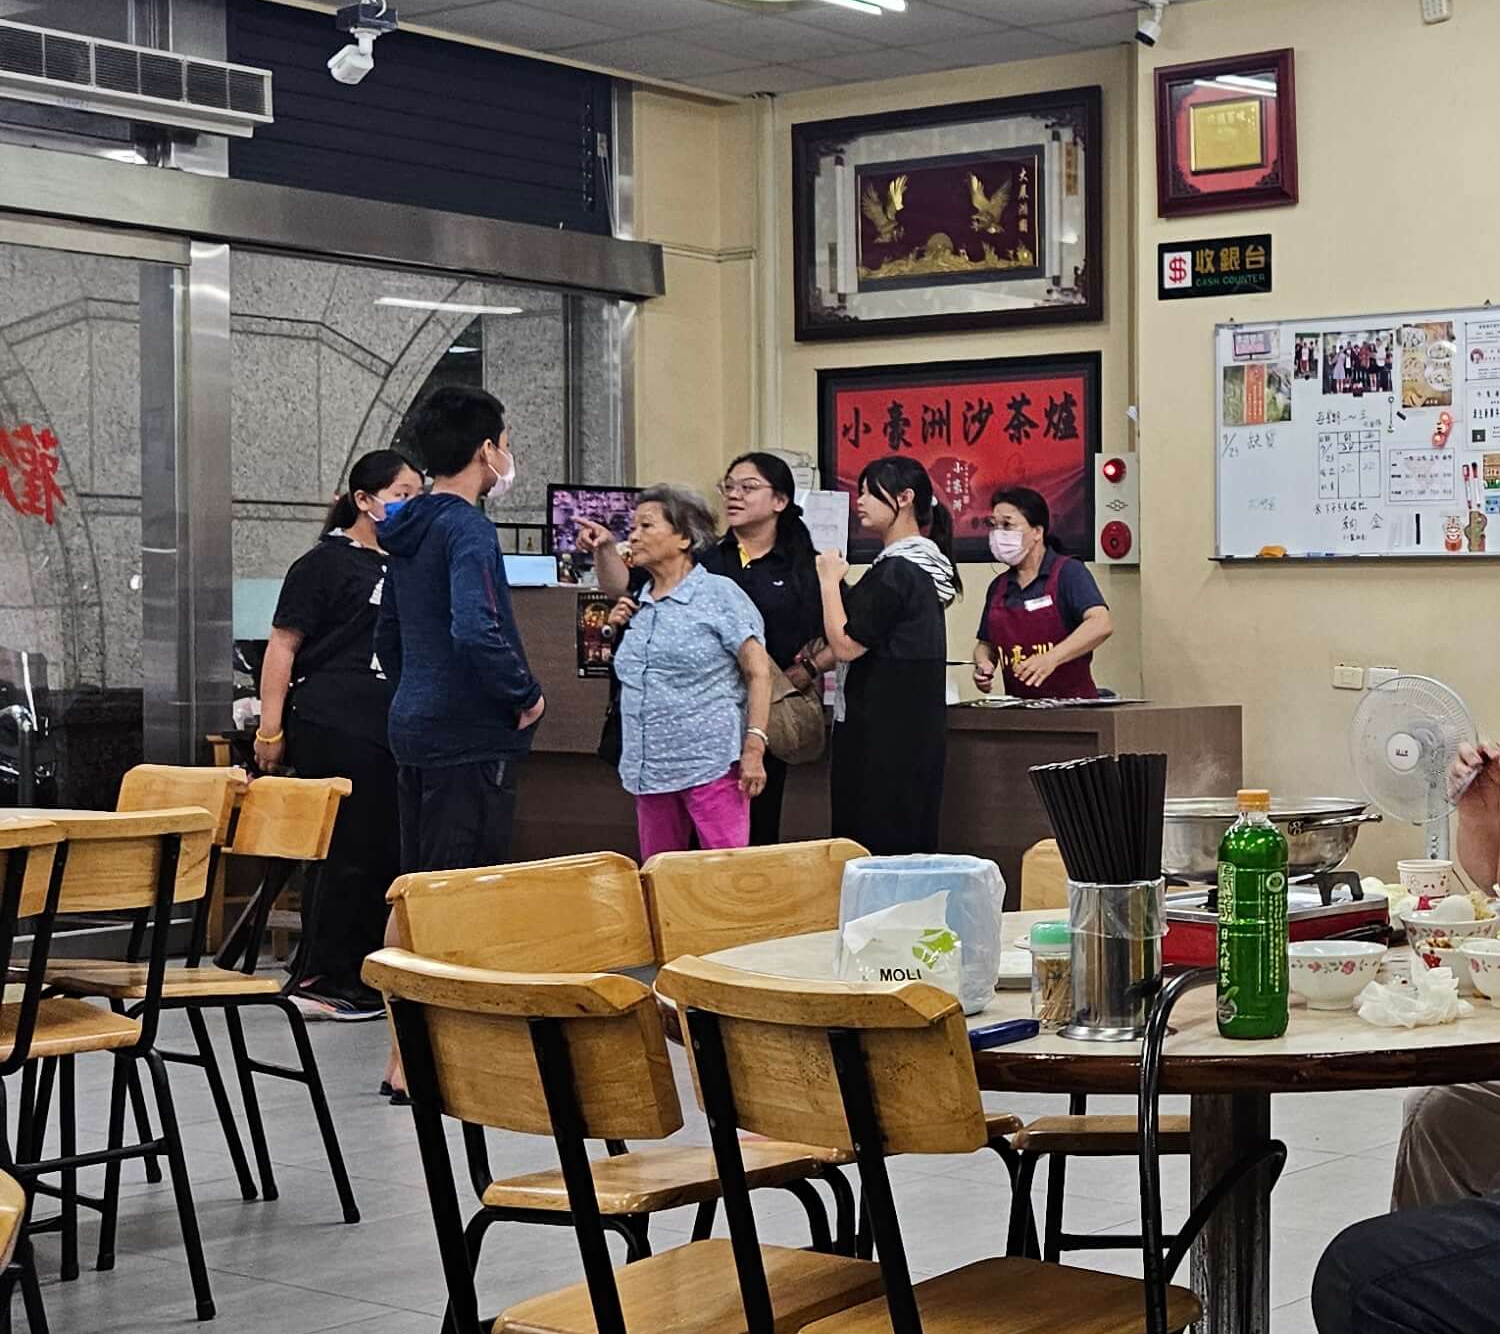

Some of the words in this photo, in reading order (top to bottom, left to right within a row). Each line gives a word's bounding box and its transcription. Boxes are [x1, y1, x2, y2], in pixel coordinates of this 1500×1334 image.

[1194, 244, 1266, 274] 收銀台
[1222, 273, 1266, 287] COUNTER
[842, 390, 1080, 451] 小豪洲沙茶爐
